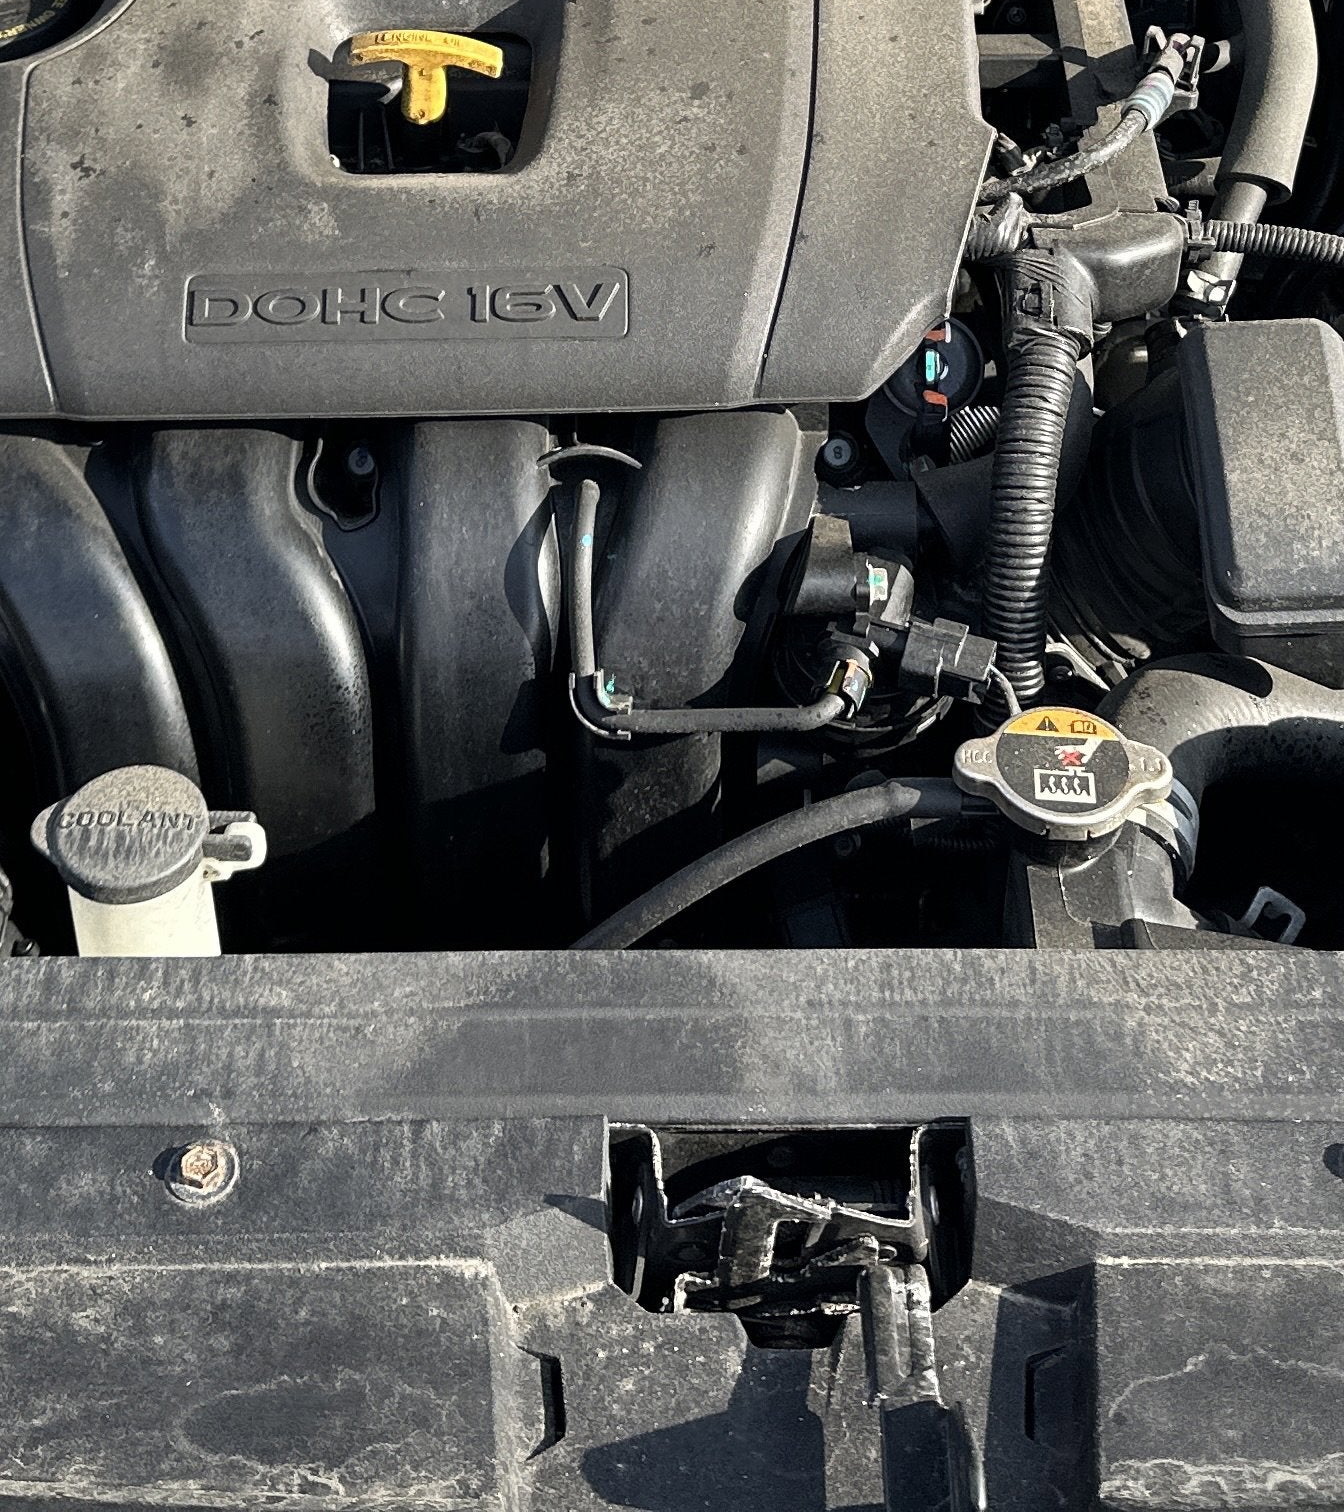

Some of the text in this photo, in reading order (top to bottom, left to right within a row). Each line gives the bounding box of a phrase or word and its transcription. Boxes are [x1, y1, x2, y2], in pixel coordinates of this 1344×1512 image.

[187, 281, 622, 327] DOHC 16V
[58, 809, 202, 831] COOLANT
